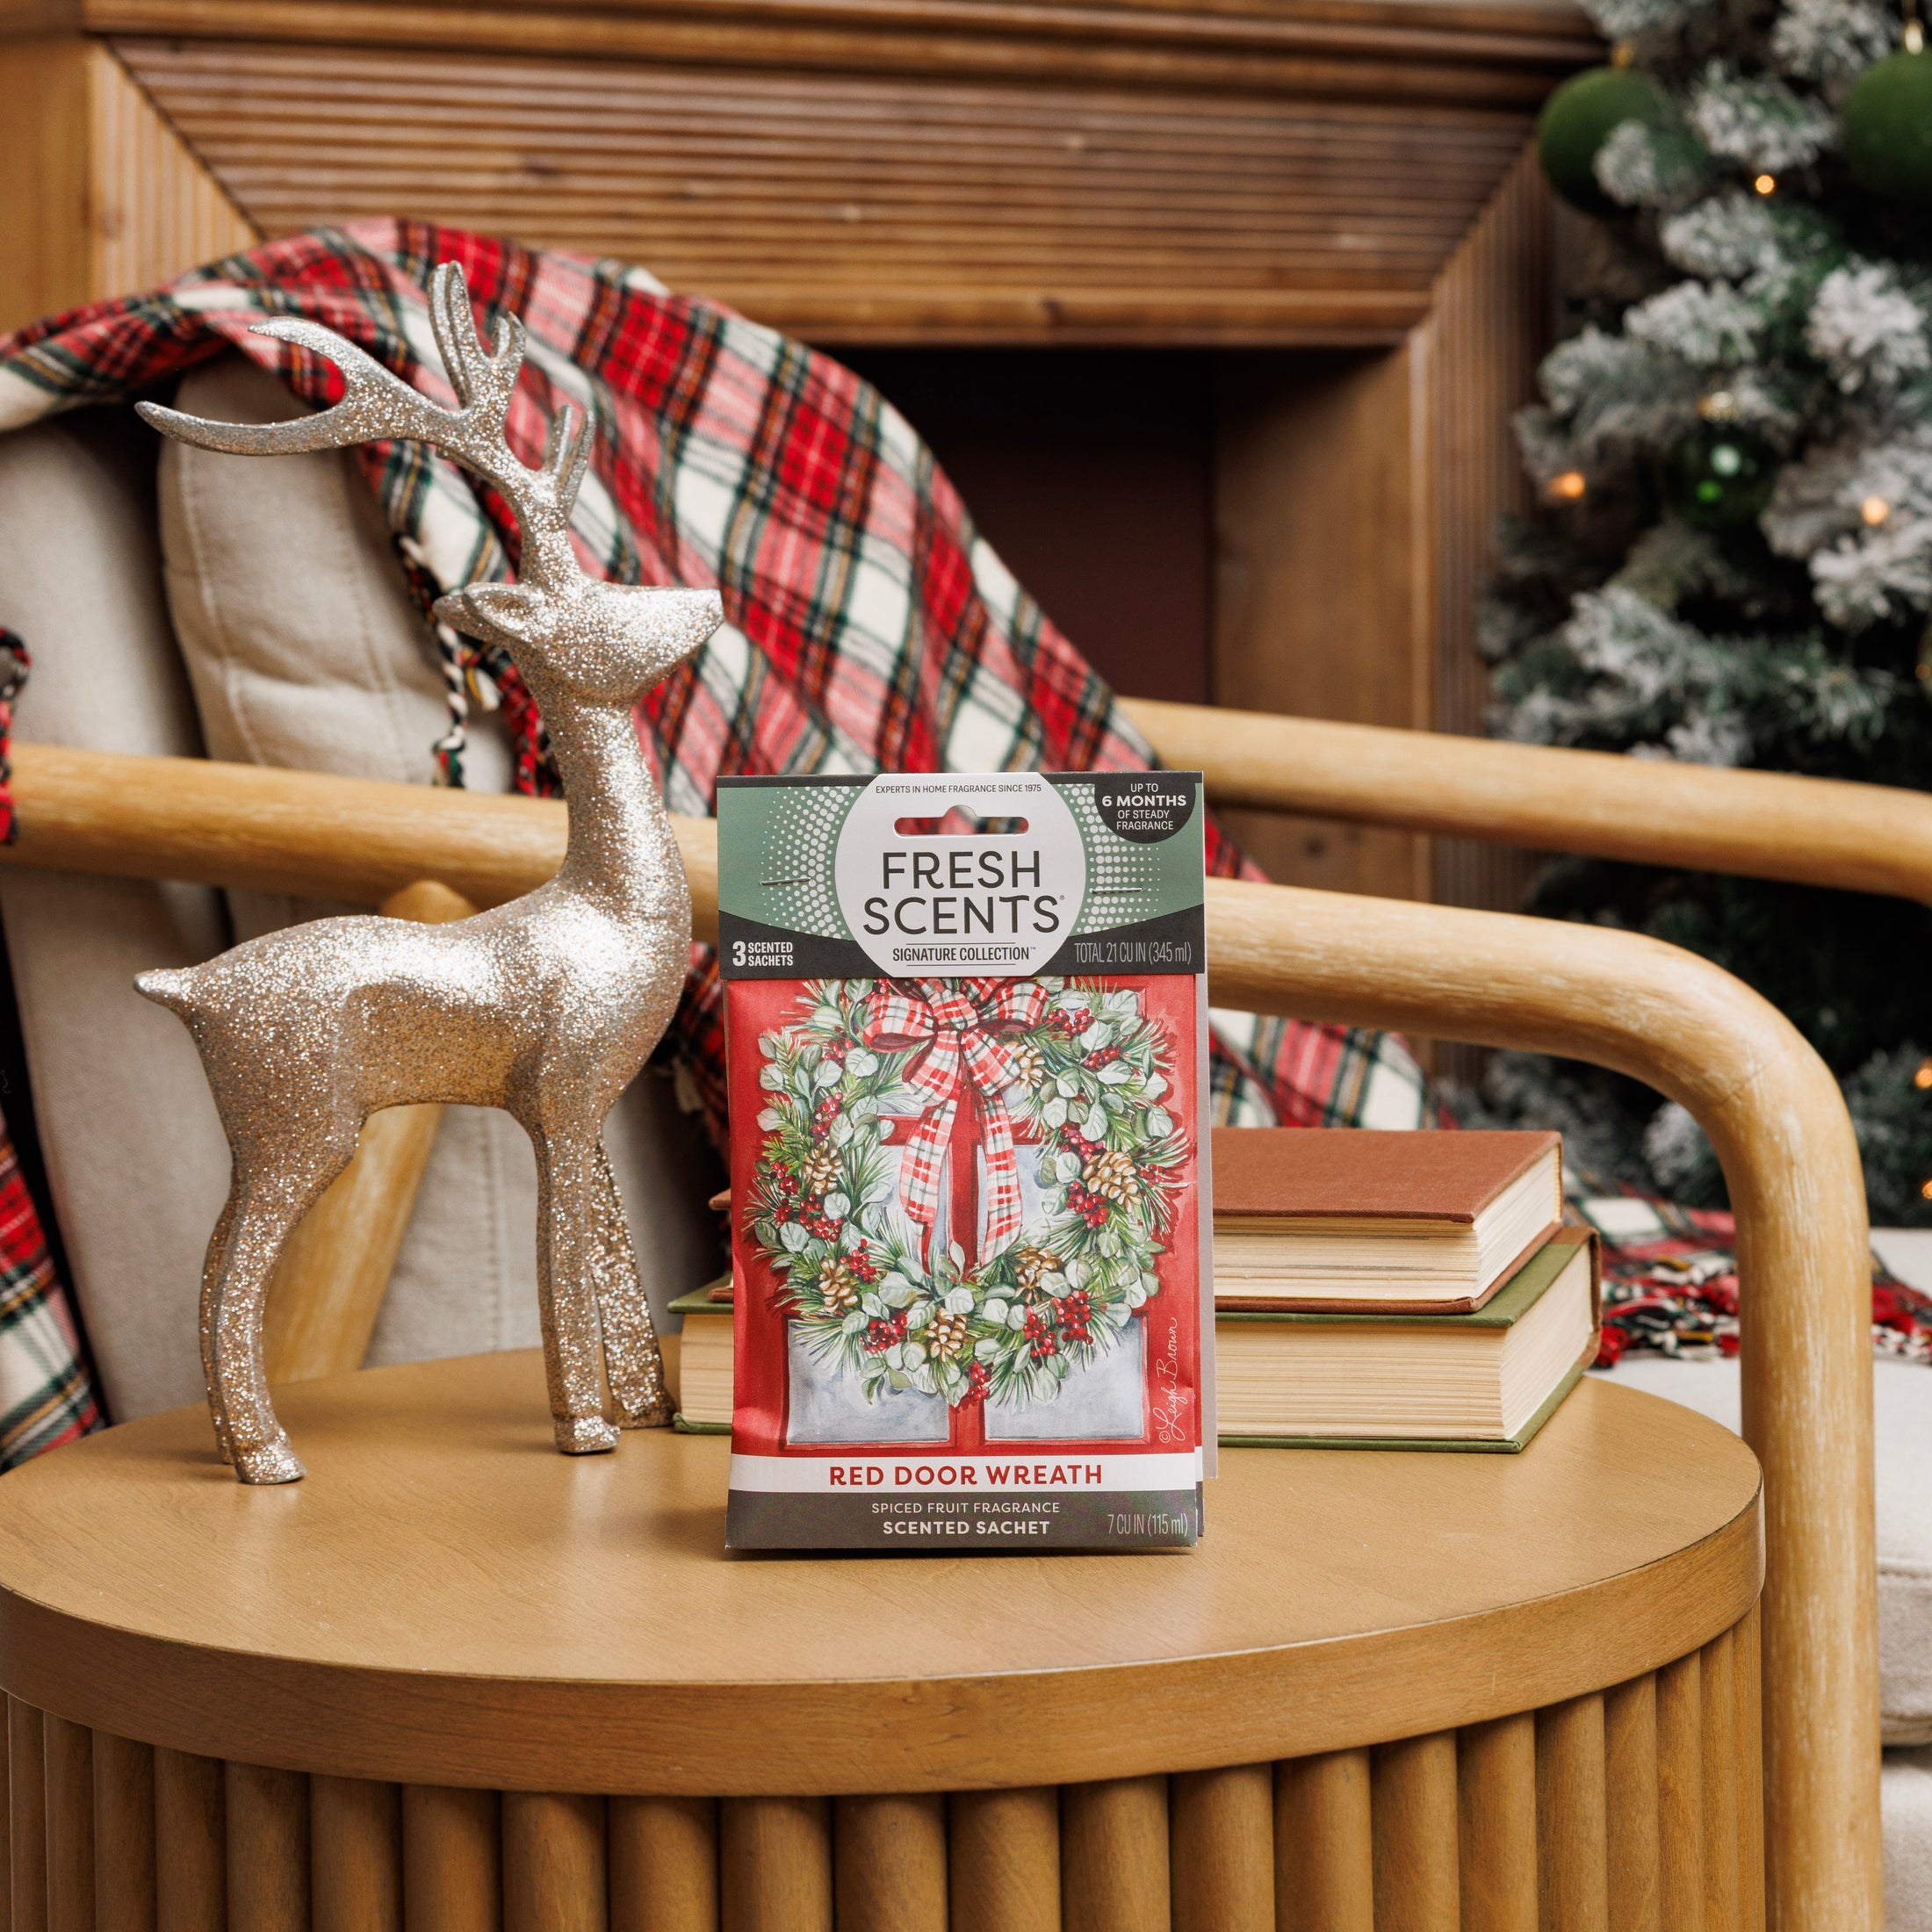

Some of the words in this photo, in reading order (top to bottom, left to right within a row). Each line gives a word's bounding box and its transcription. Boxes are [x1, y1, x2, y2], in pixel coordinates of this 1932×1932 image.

[948, 784, 997, 793] FRAGRANCE
[1130, 783, 1143, 793] UP
[1145, 782, 1159, 793] TO
[1101, 795, 1112, 807] 6
[1116, 795, 1186, 807] MONTHS
[1117, 810, 1130, 819] OF
[1132, 810, 1170, 819] STEADY
[1116, 821, 1174, 831] FRAGRANCE
[883, 850, 1040, 890] FRESH
[732, 941, 746, 967] 3
[747, 941, 794, 954] SCENTED
[1074, 942, 1105, 963] TOTAL
[1107, 941, 1117, 962] 21
[1119, 941, 1133, 962] CU
[1135, 941, 1146, 962] IN
[1148, 941, 1172, 965] (345
[1175, 941, 1192, 965] ml)
[747, 955, 794, 967] SACHETS
[892, 948, 957, 962] SIGNATURE
[1156, 1316, 1179, 1381] Brown
[830, 1466, 884, 1486] RED
[894, 1465, 977, 1486] DOOR
[985, 1464, 1102, 1485] WREATH
[871, 1503, 922, 1514] SPICED
[927, 1503, 969, 1514] FRUIT
[973, 1502, 1060, 1513] FRAGRANCE
[882, 1521, 970, 1535] SCENTED
[976, 1521, 1050, 1535] SACHET
[1107, 1514, 1114, 1535] 7
[1116, 1513, 1131, 1535] CU
[1134, 1513, 1144, 1535] IN
[1147, 1513, 1169, 1537] (115
[1171, 1512, 1188, 1537] ml)
